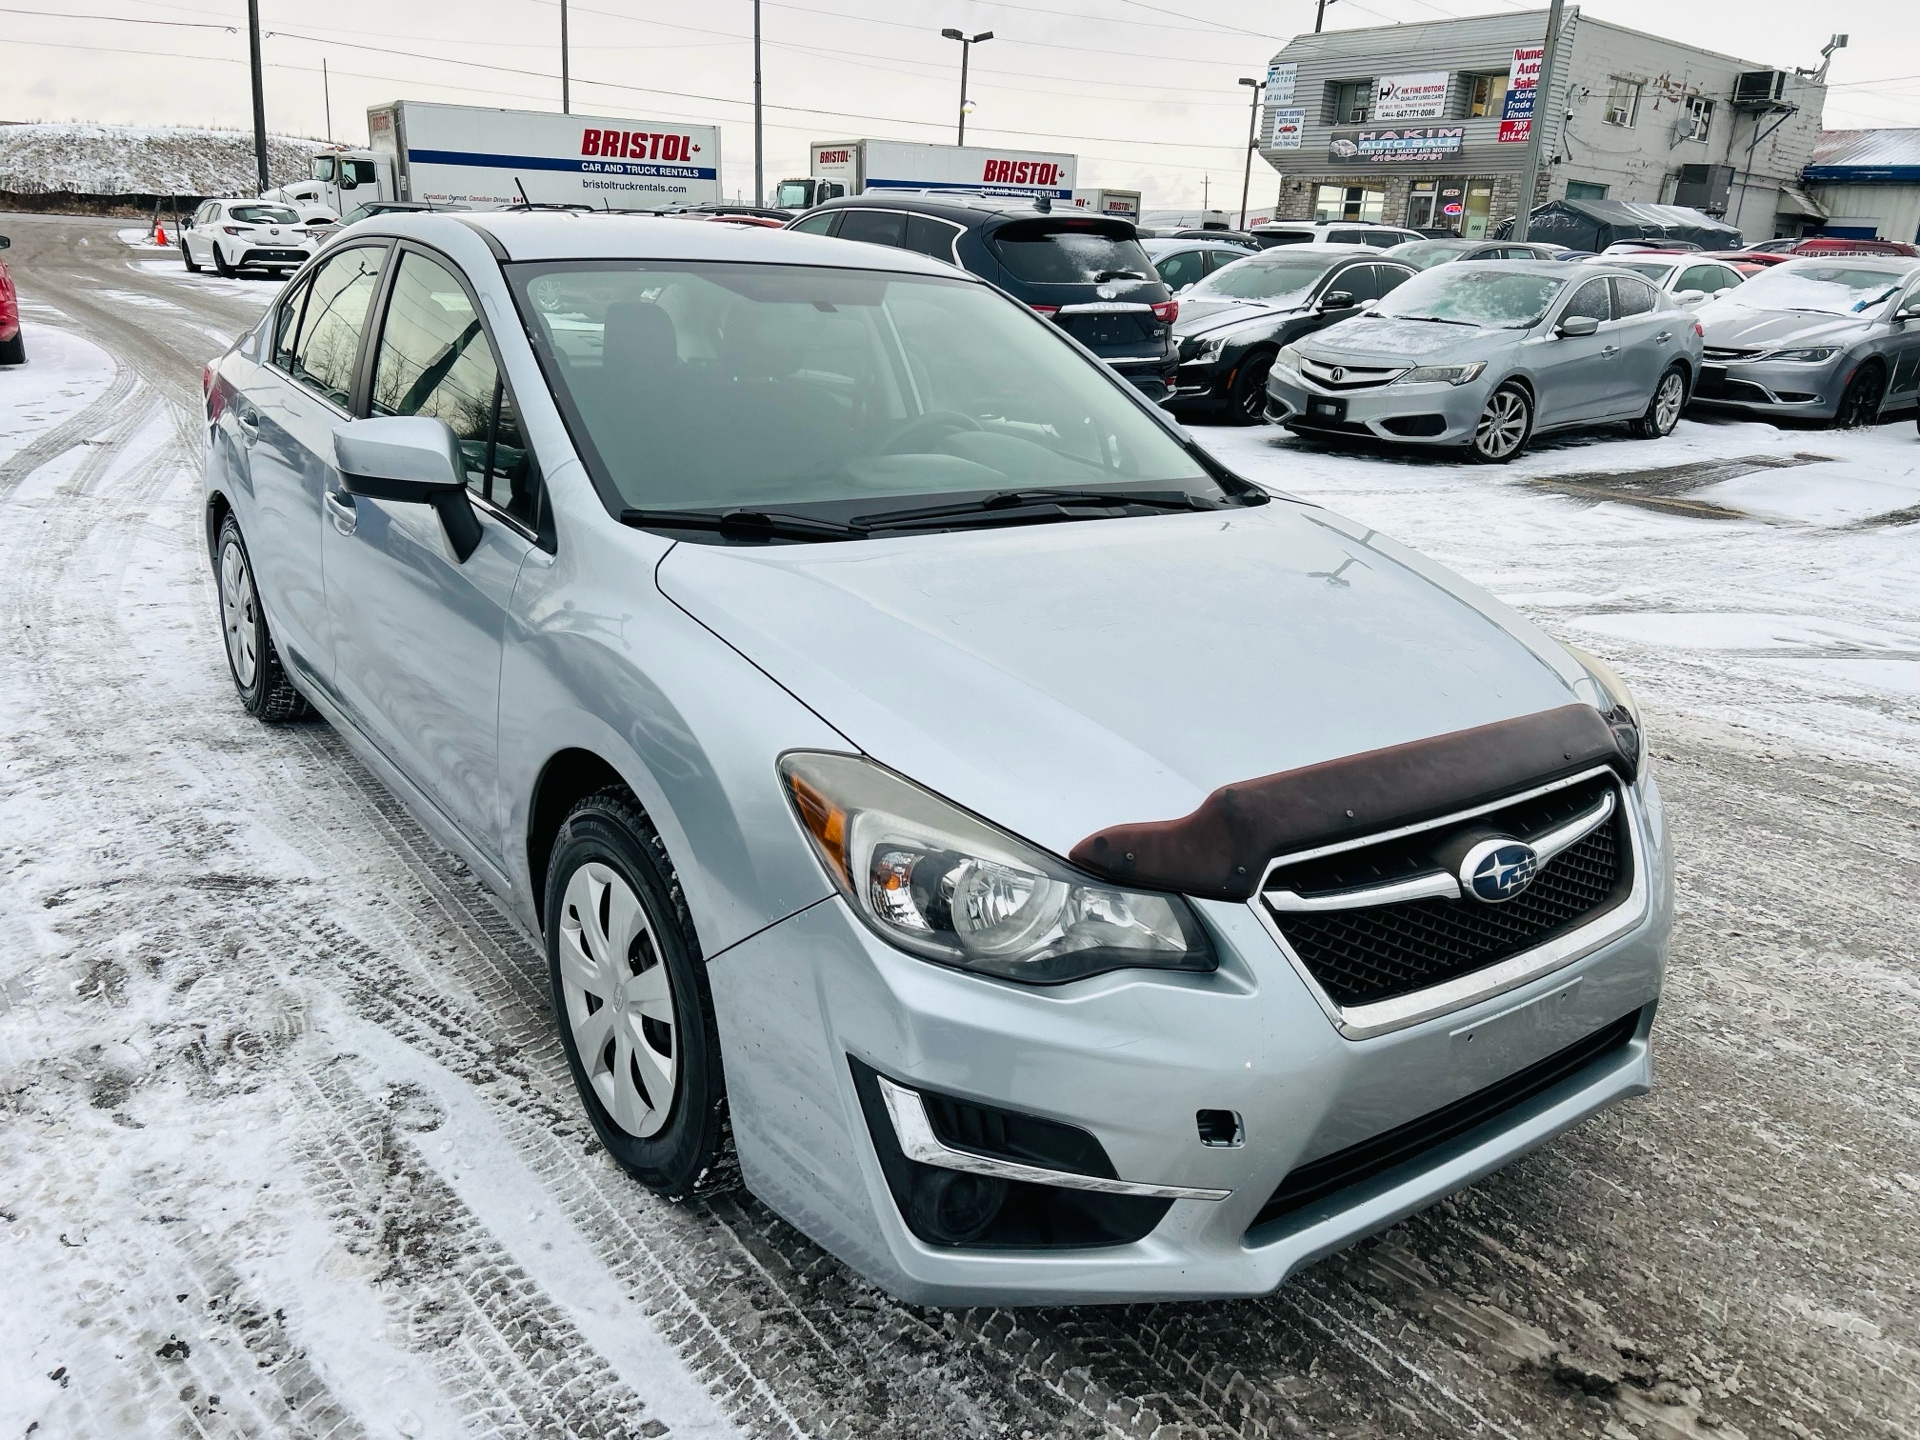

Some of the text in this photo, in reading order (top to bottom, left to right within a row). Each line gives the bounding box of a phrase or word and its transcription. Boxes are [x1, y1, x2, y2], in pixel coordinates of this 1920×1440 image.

[1514, 49, 1544, 60] Nume
[1423, 85, 1445, 93] MOTORS
[1508, 100, 1530, 109] Trade
[1507, 110, 1533, 118] Financ
[1513, 122, 1527, 130] 289
[1359, 128, 1463, 140] HAKIM
[581, 129, 691, 161] BRISTOL
[1359, 138, 1460, 149] AUTO SALE
[820, 150, 849, 163] BRISTOL
[582, 162, 699, 177] CAR AND TRUCK RENTALS
[983, 159, 1058, 185] BRISTOL
[583, 179, 687, 193] bristoltruckrentals.com
